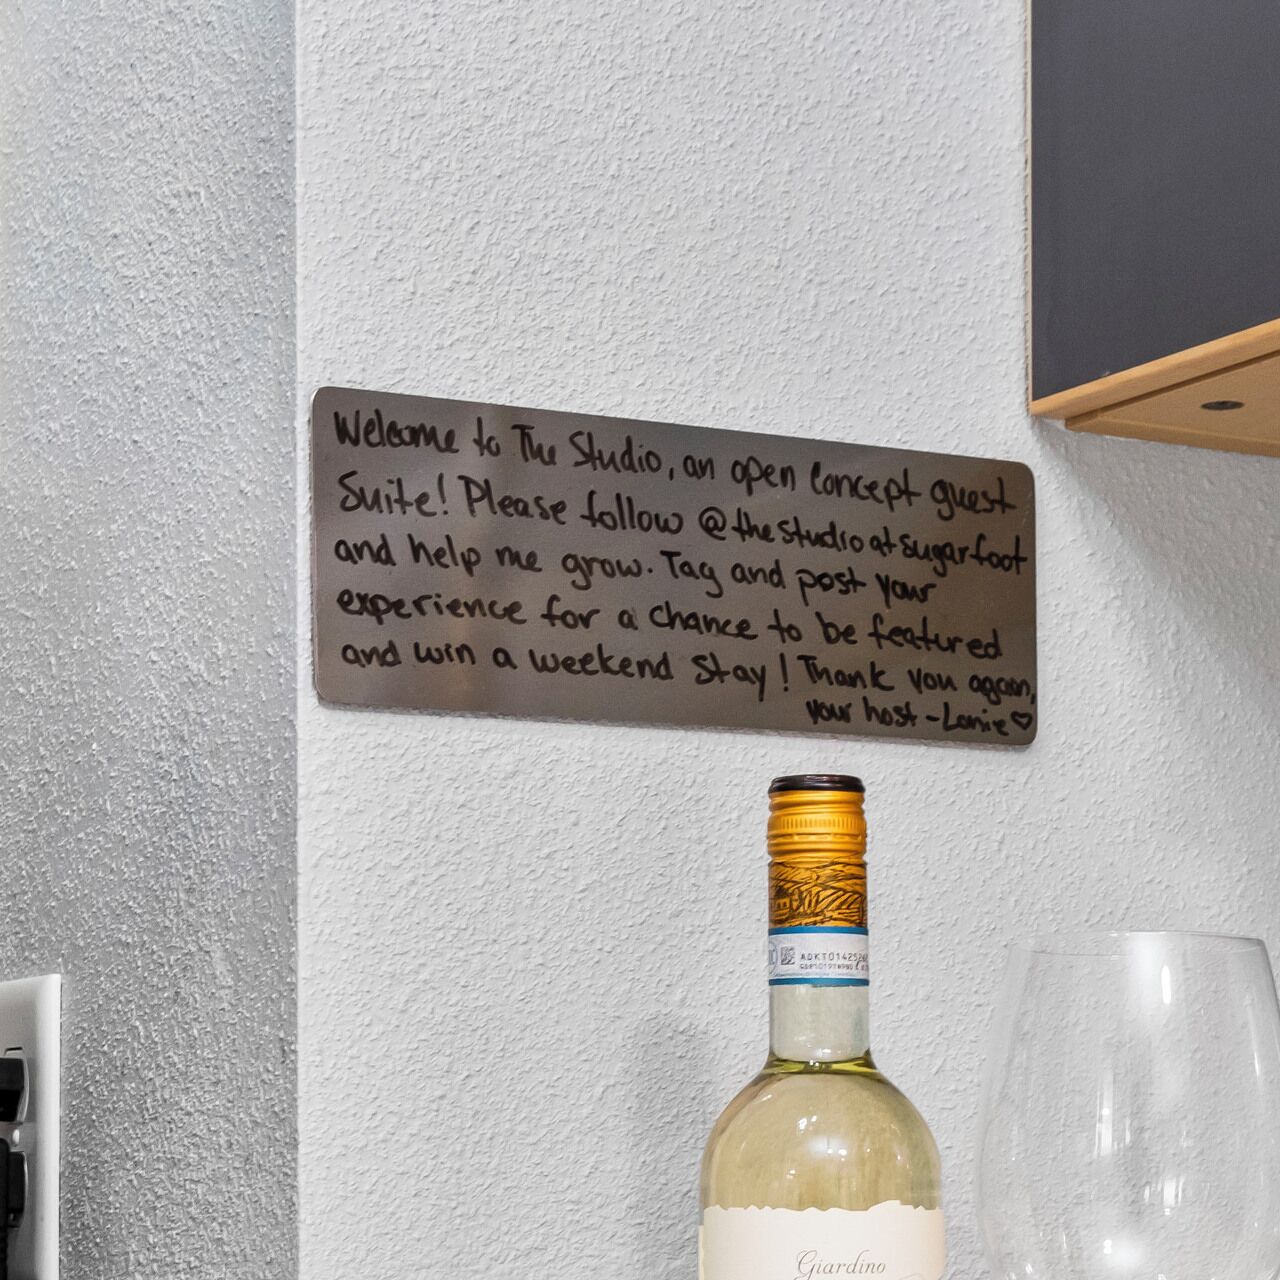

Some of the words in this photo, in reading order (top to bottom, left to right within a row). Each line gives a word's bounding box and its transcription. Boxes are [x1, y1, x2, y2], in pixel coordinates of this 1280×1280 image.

[333, 408, 460, 453] Welcome
[473, 416, 502, 456] to
[511, 423, 558, 465] The
[569, 430, 674, 481] Studio,
[683, 455, 716, 480] an
[731, 455, 796, 496] open
[930, 477, 1017, 521] guest
[337, 469, 450, 517] Suite!
[458, 475, 567, 525] Please
[579, 490, 684, 535] follow
[334, 532, 397, 566] and
[407, 532, 482, 577] help
[495, 545, 543, 573] me
[561, 552, 654, 591] grow.
[659, 550, 724, 599] Tag
[731, 559, 787, 588] and
[795, 566, 867, 607] post
[874, 572, 937, 609] your
[336, 588, 528, 626] experience
[541, 594, 601, 629] for
[617, 608, 639, 631] a
[767, 608, 803, 644] to
[815, 611, 858, 645] be
[867, 612, 1004, 660] featured
[340, 639, 402, 668] and
[413, 641, 477, 665] win
[492, 646, 518, 670] a
[528, 643, 674, 681] weekend
[797, 653, 895, 692] Thank
[907, 667, 958, 695] you
[806, 698, 852, 725] your
[862, 696, 918, 727] host
